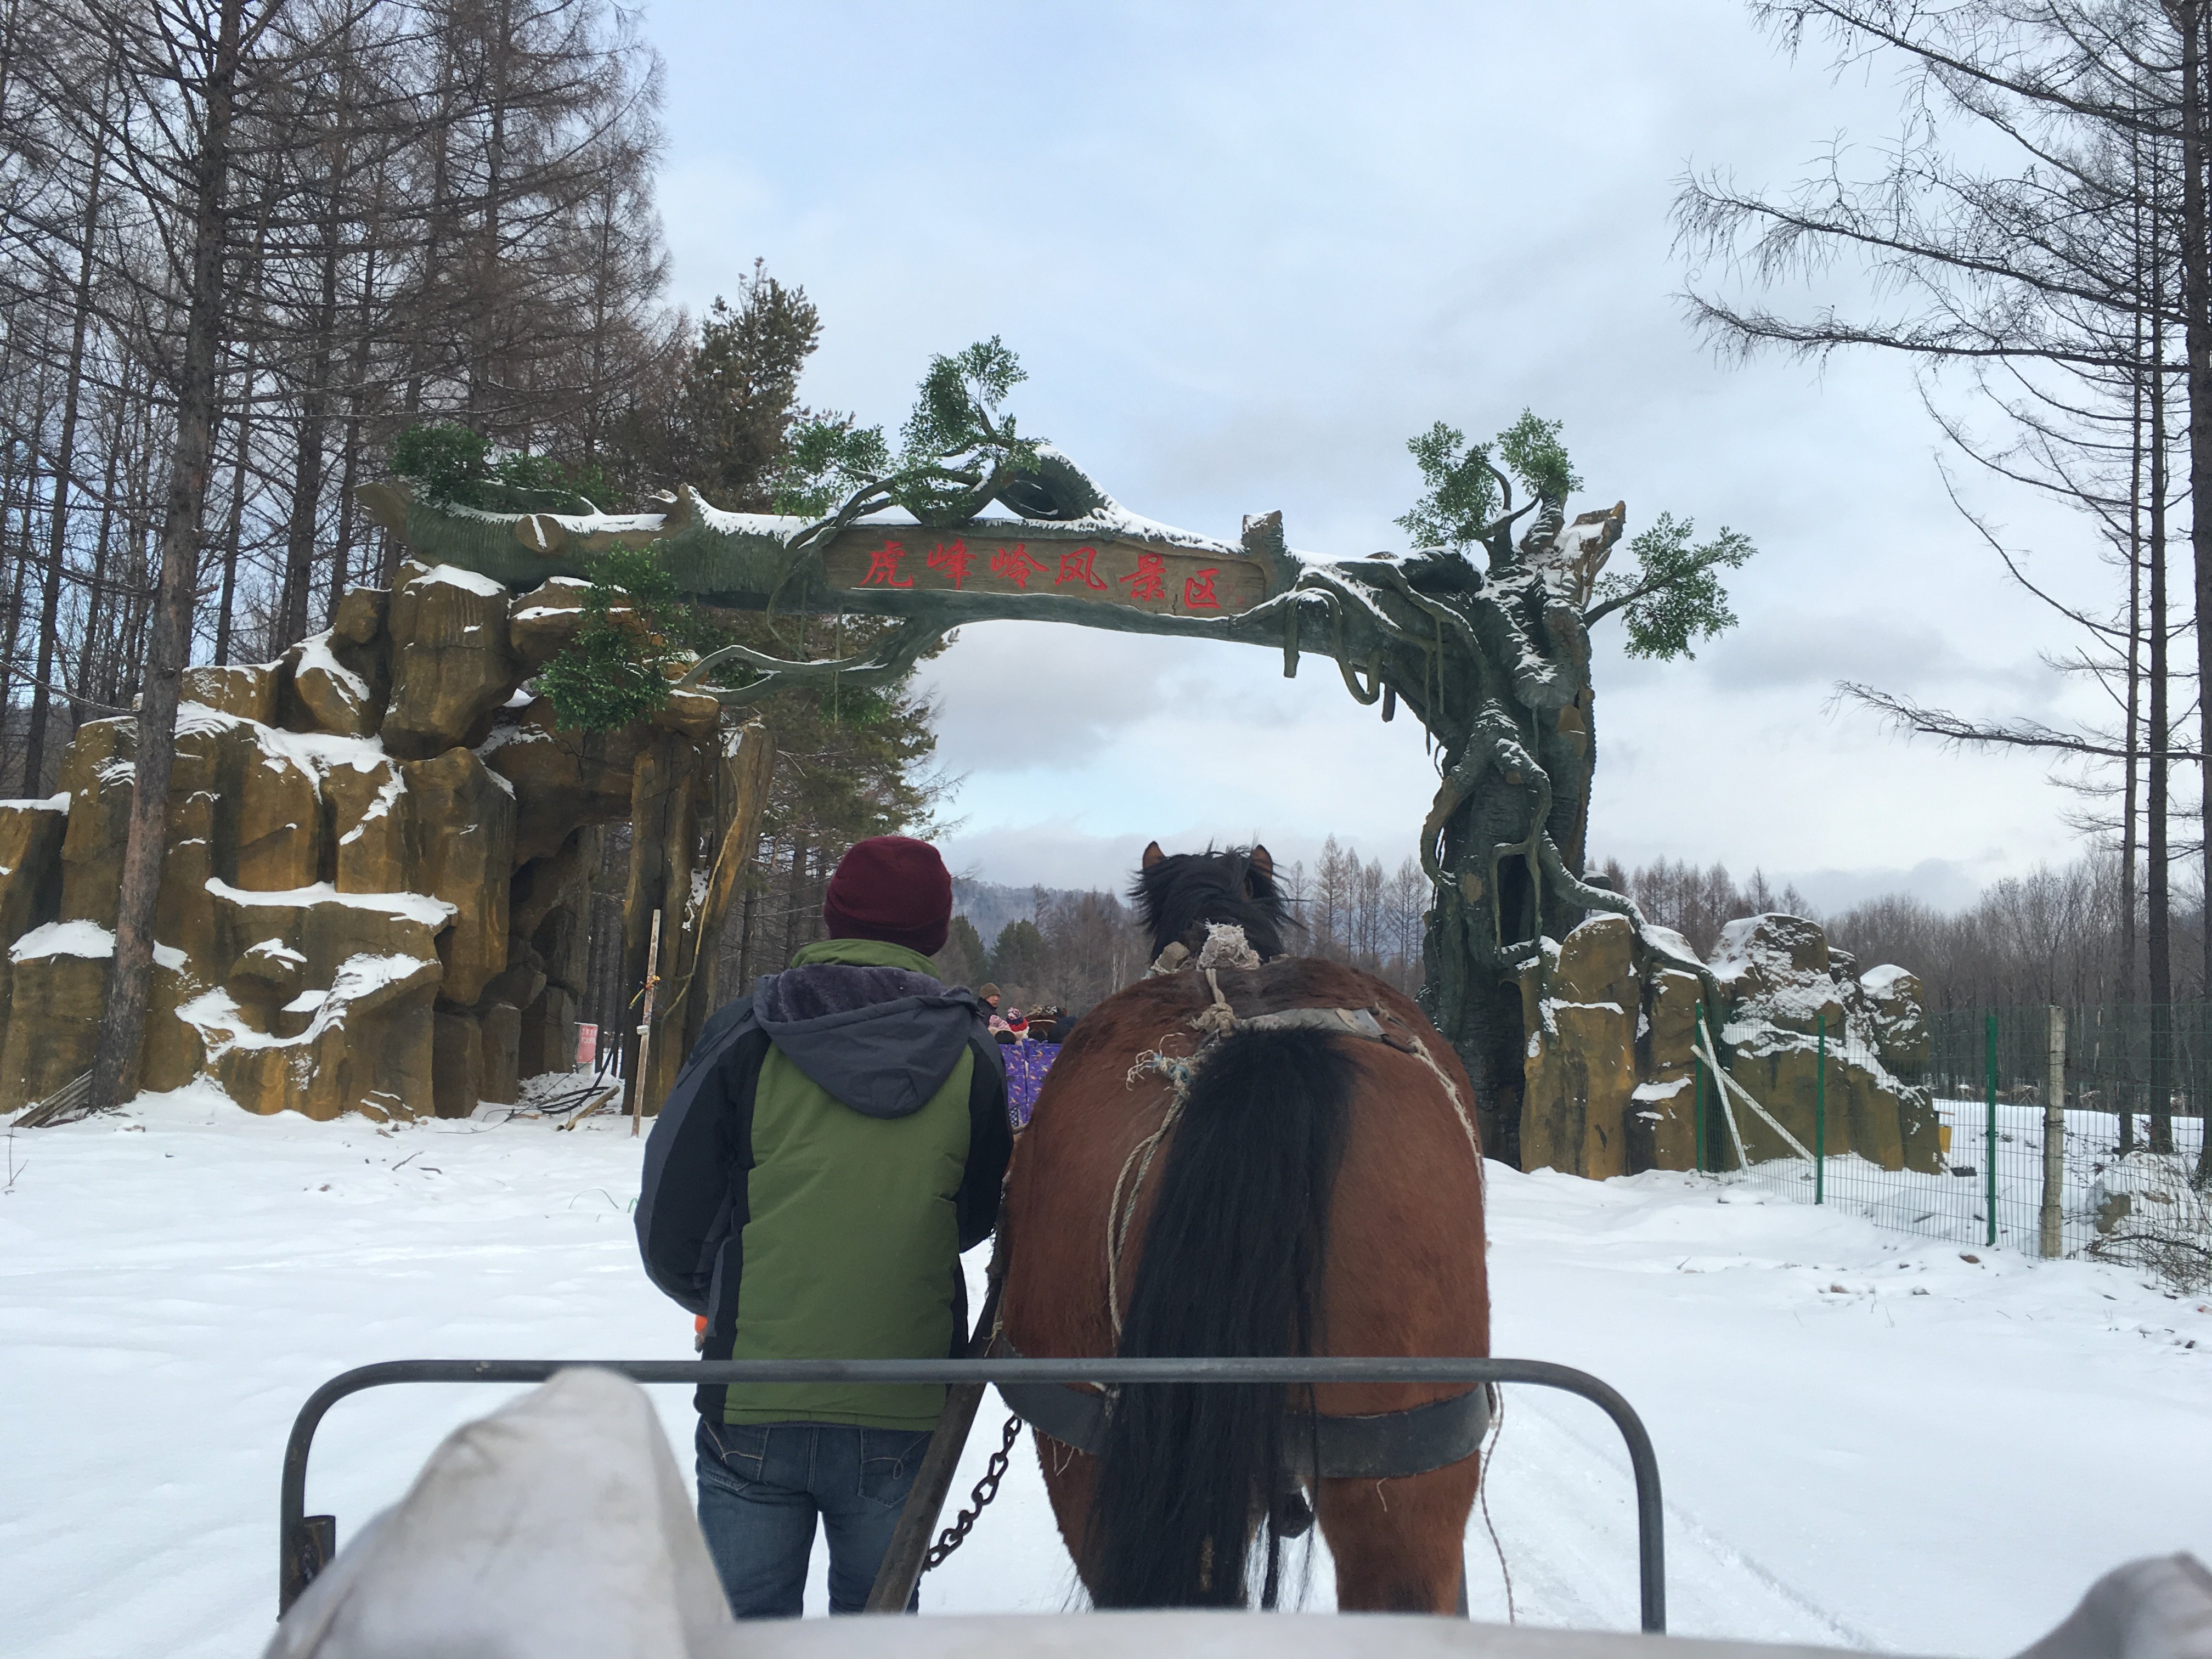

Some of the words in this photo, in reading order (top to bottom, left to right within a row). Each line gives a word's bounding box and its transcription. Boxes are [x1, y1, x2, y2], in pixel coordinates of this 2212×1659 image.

[860, 538, 1221, 610] 虎峰岭风景区
